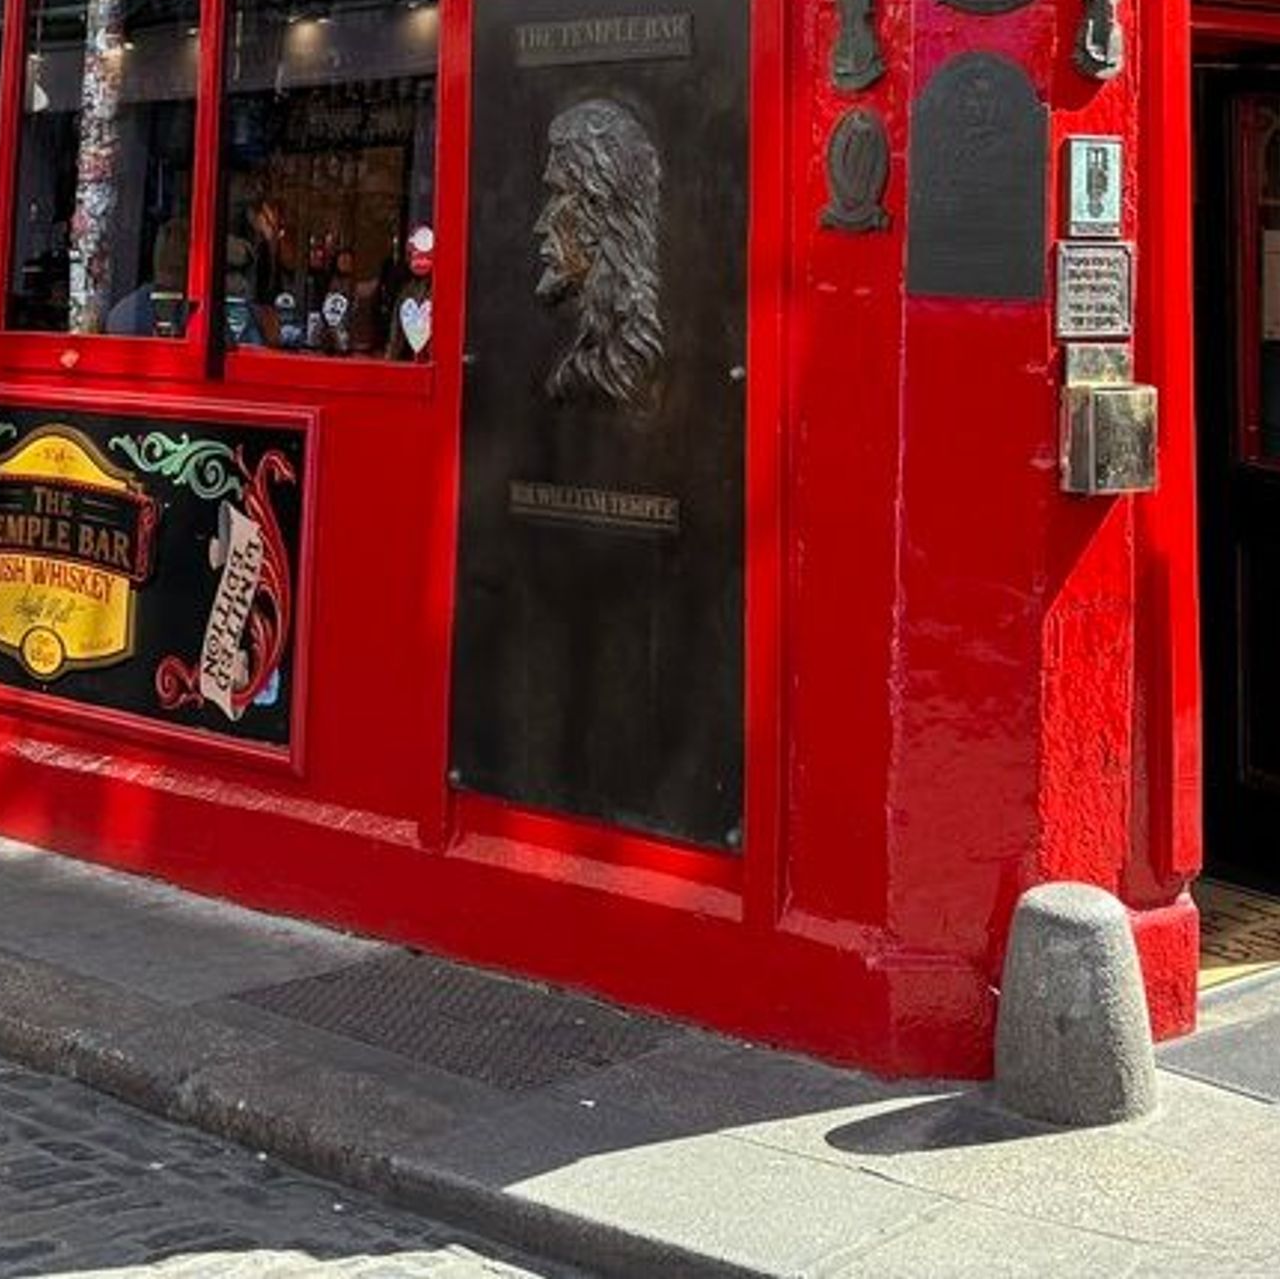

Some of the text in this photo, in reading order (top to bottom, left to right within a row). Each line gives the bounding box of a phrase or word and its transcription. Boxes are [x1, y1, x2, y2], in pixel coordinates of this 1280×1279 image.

[554, 19, 639, 47] TEMPLE
[33, 486, 73, 516] THE
[78, 524, 132, 570] BAR
[32, 559, 116, 604] WHISKEY
[203, 548, 244, 678] EDITION
[216, 540, 261, 692] LIMITED
